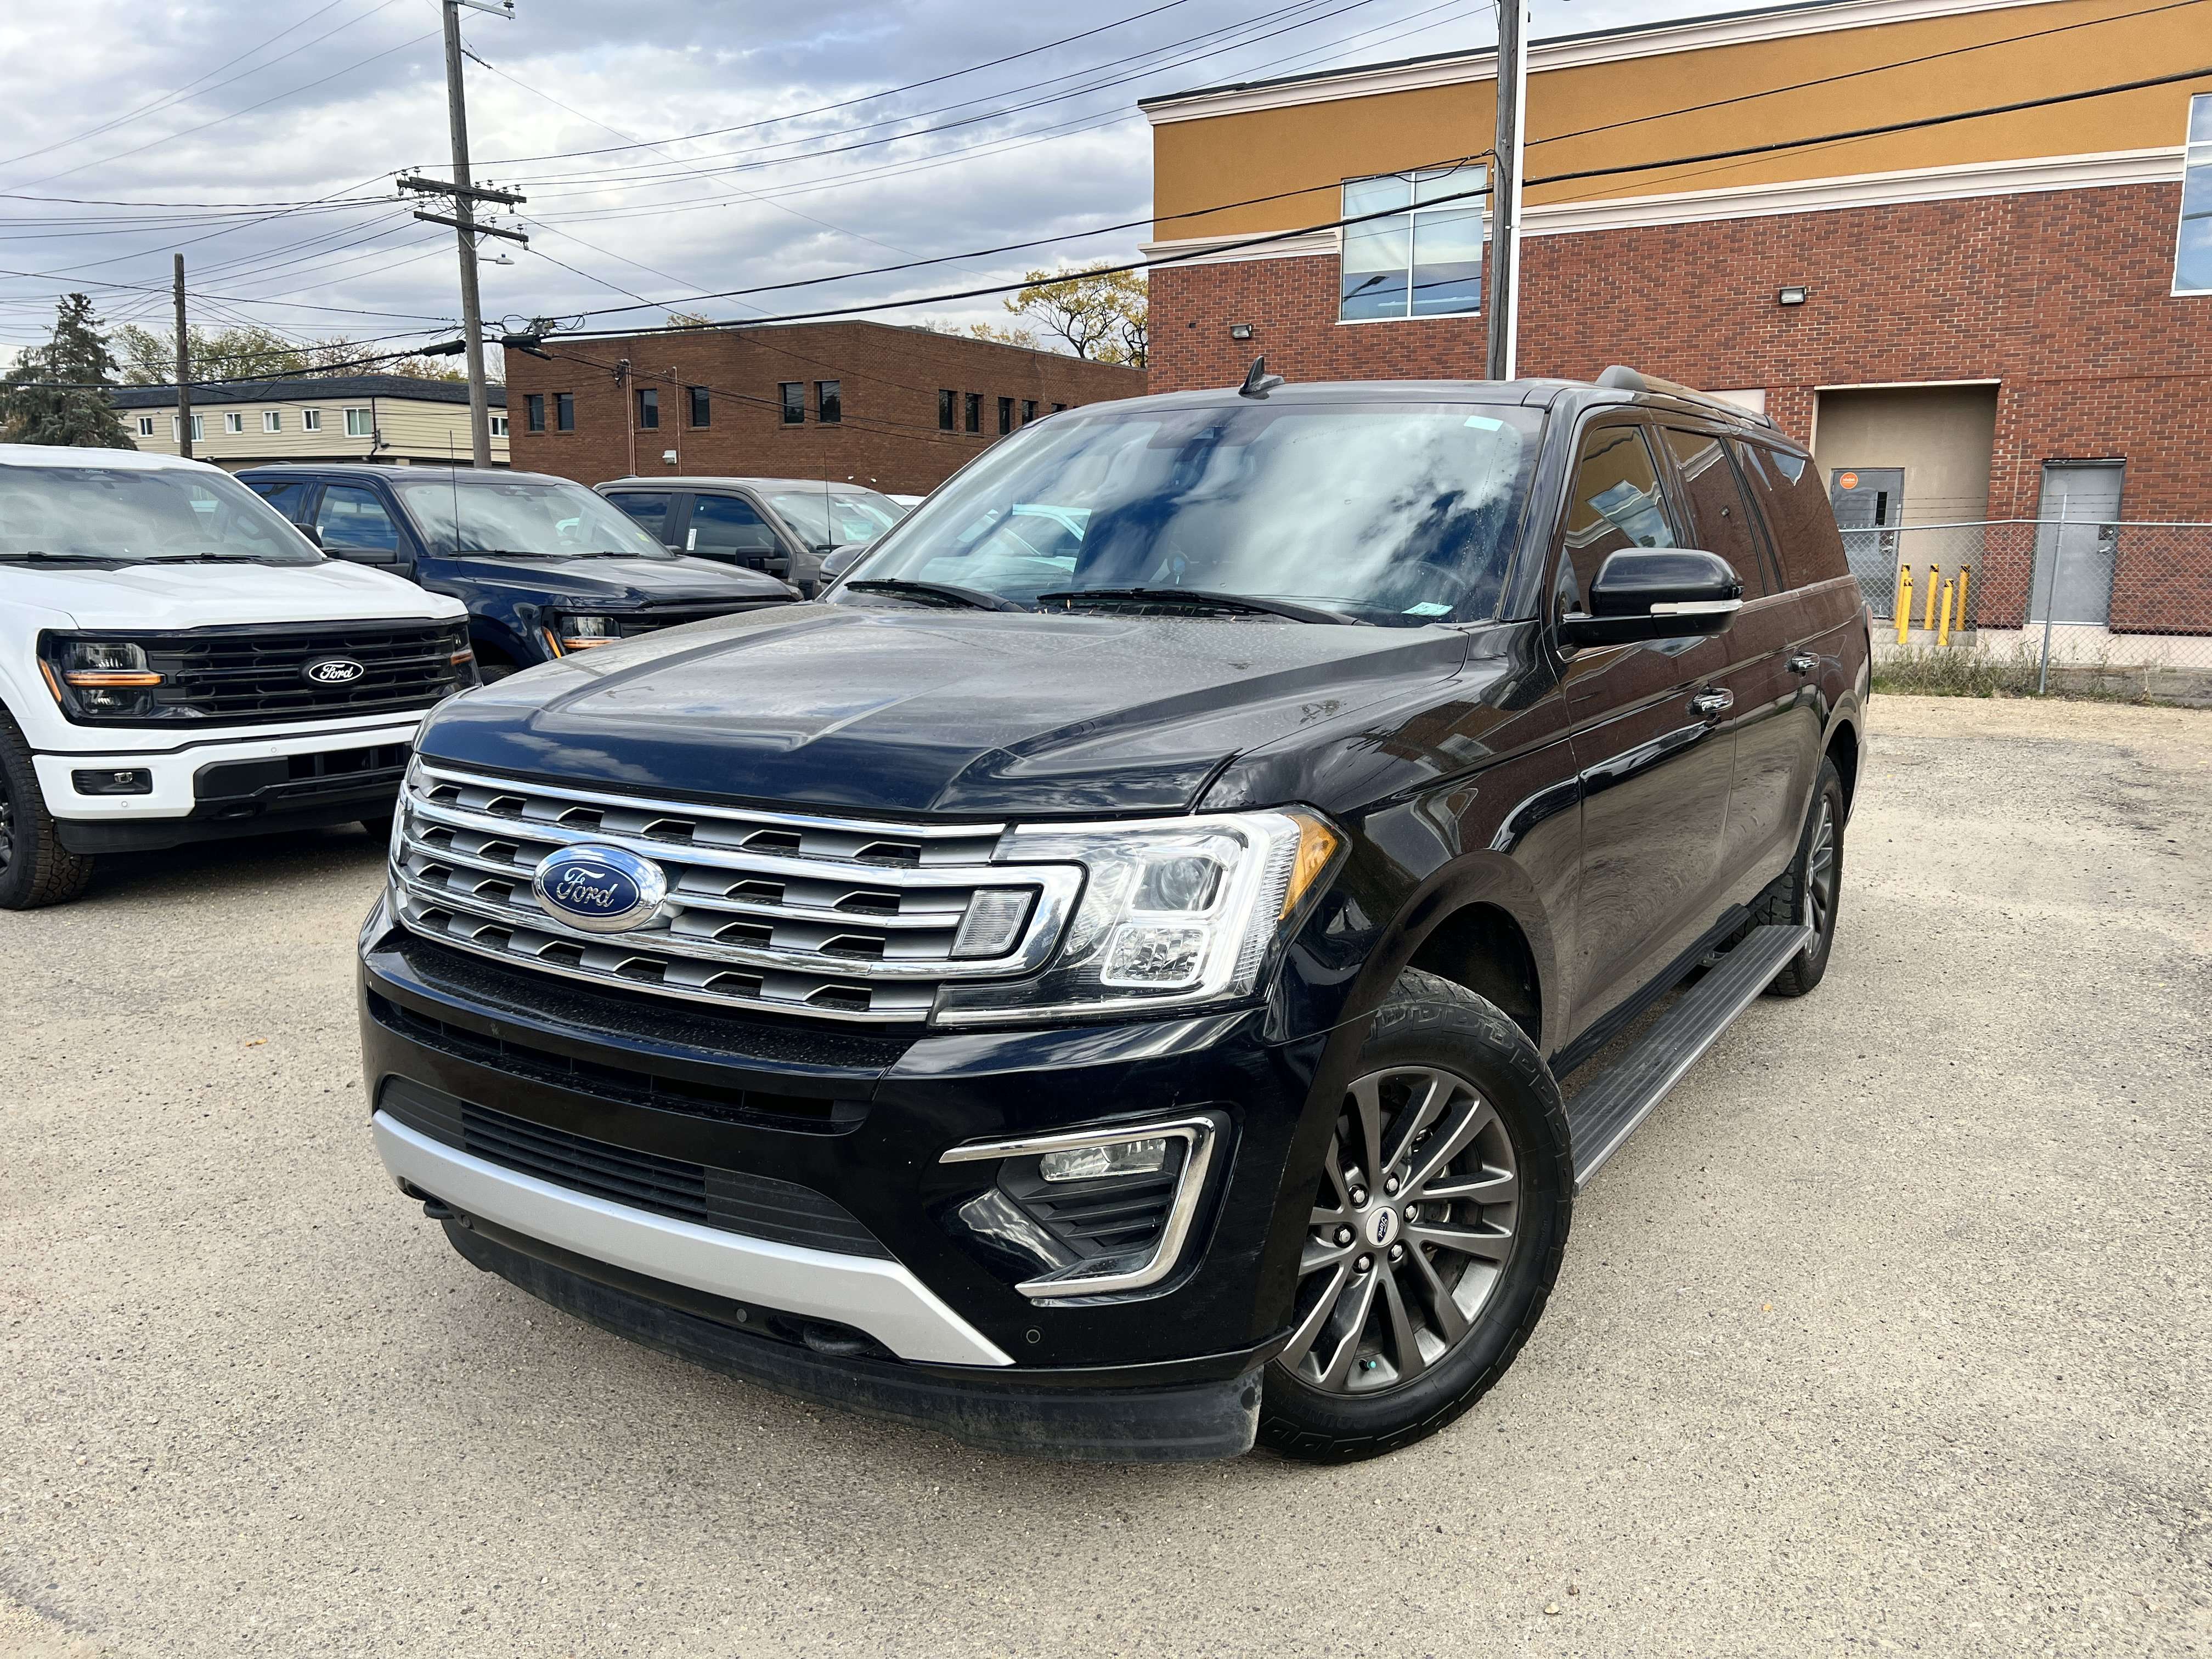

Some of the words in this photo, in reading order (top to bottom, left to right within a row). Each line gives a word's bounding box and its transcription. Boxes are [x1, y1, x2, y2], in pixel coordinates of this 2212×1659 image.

[319, 663, 354, 680] Ford
[556, 867, 618, 907] Ford
[1378, 1216, 1388, 1238] Ford
